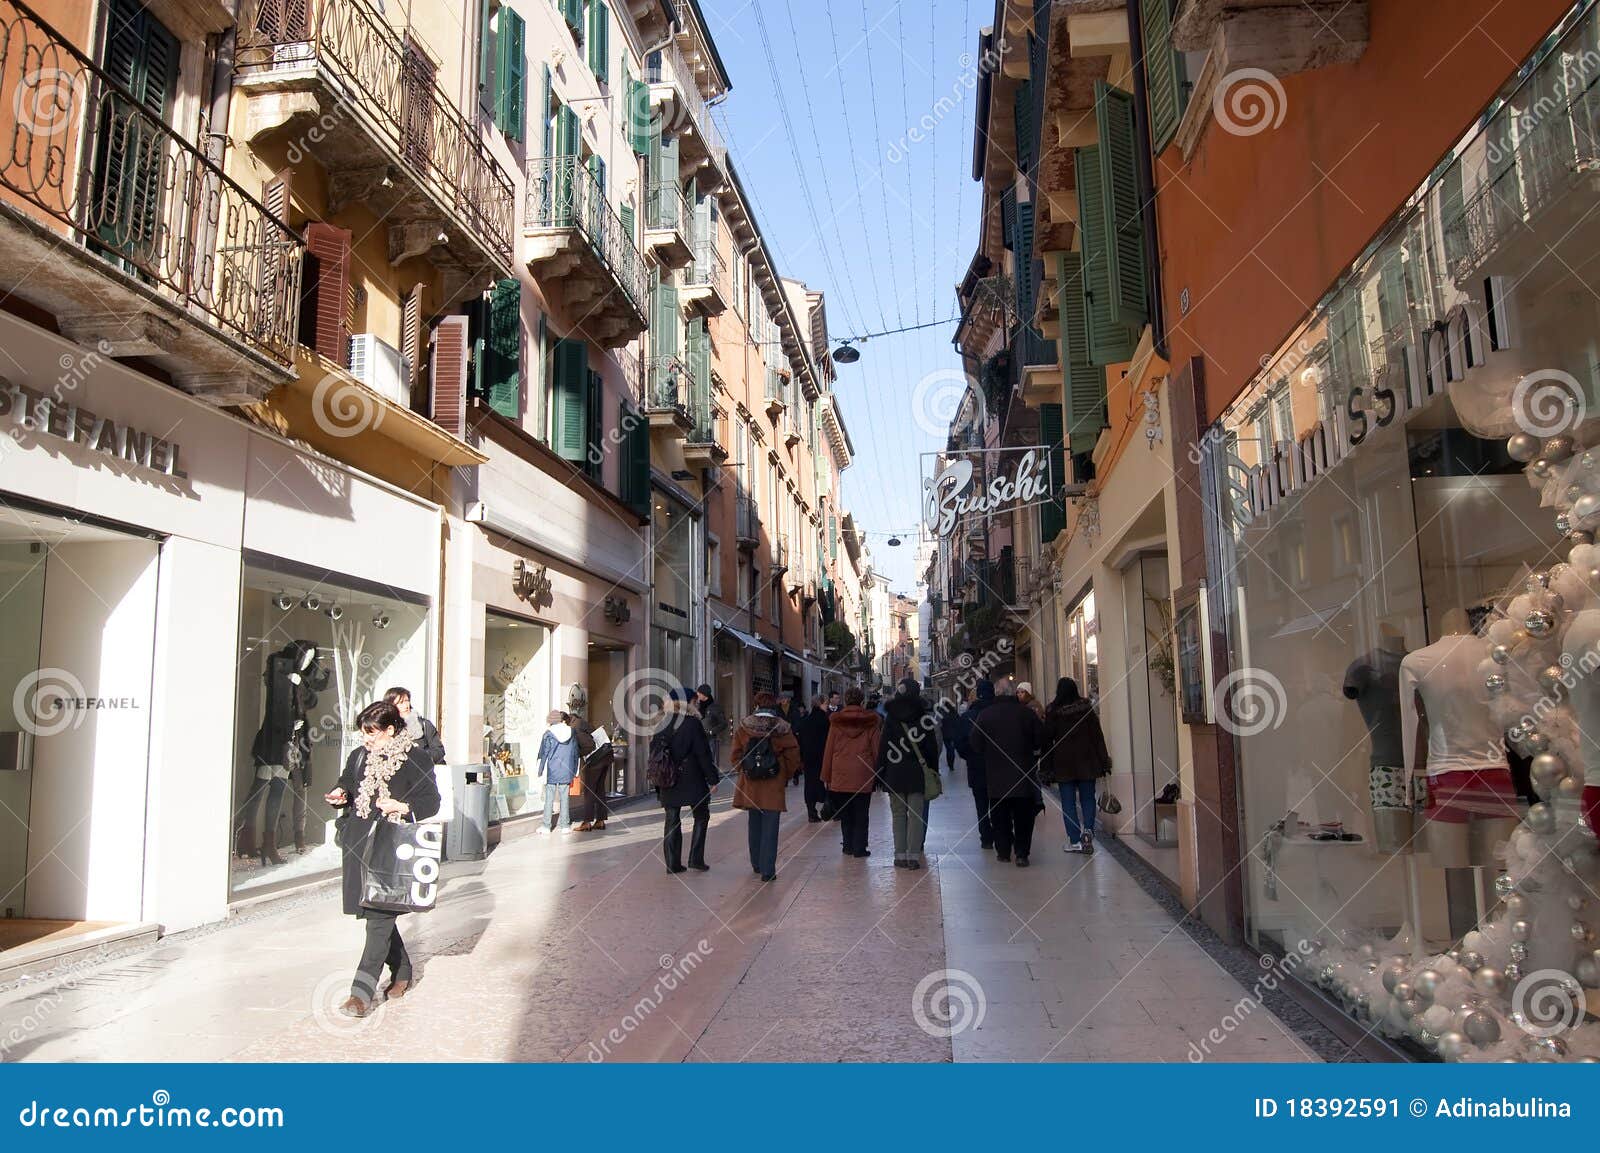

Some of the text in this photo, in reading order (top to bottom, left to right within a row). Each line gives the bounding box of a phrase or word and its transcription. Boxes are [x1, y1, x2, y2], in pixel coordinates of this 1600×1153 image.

[924, 450, 1047, 537] Bruschi
[53, 697, 140, 710] STEFANEL
[396, 823, 442, 907] coin
